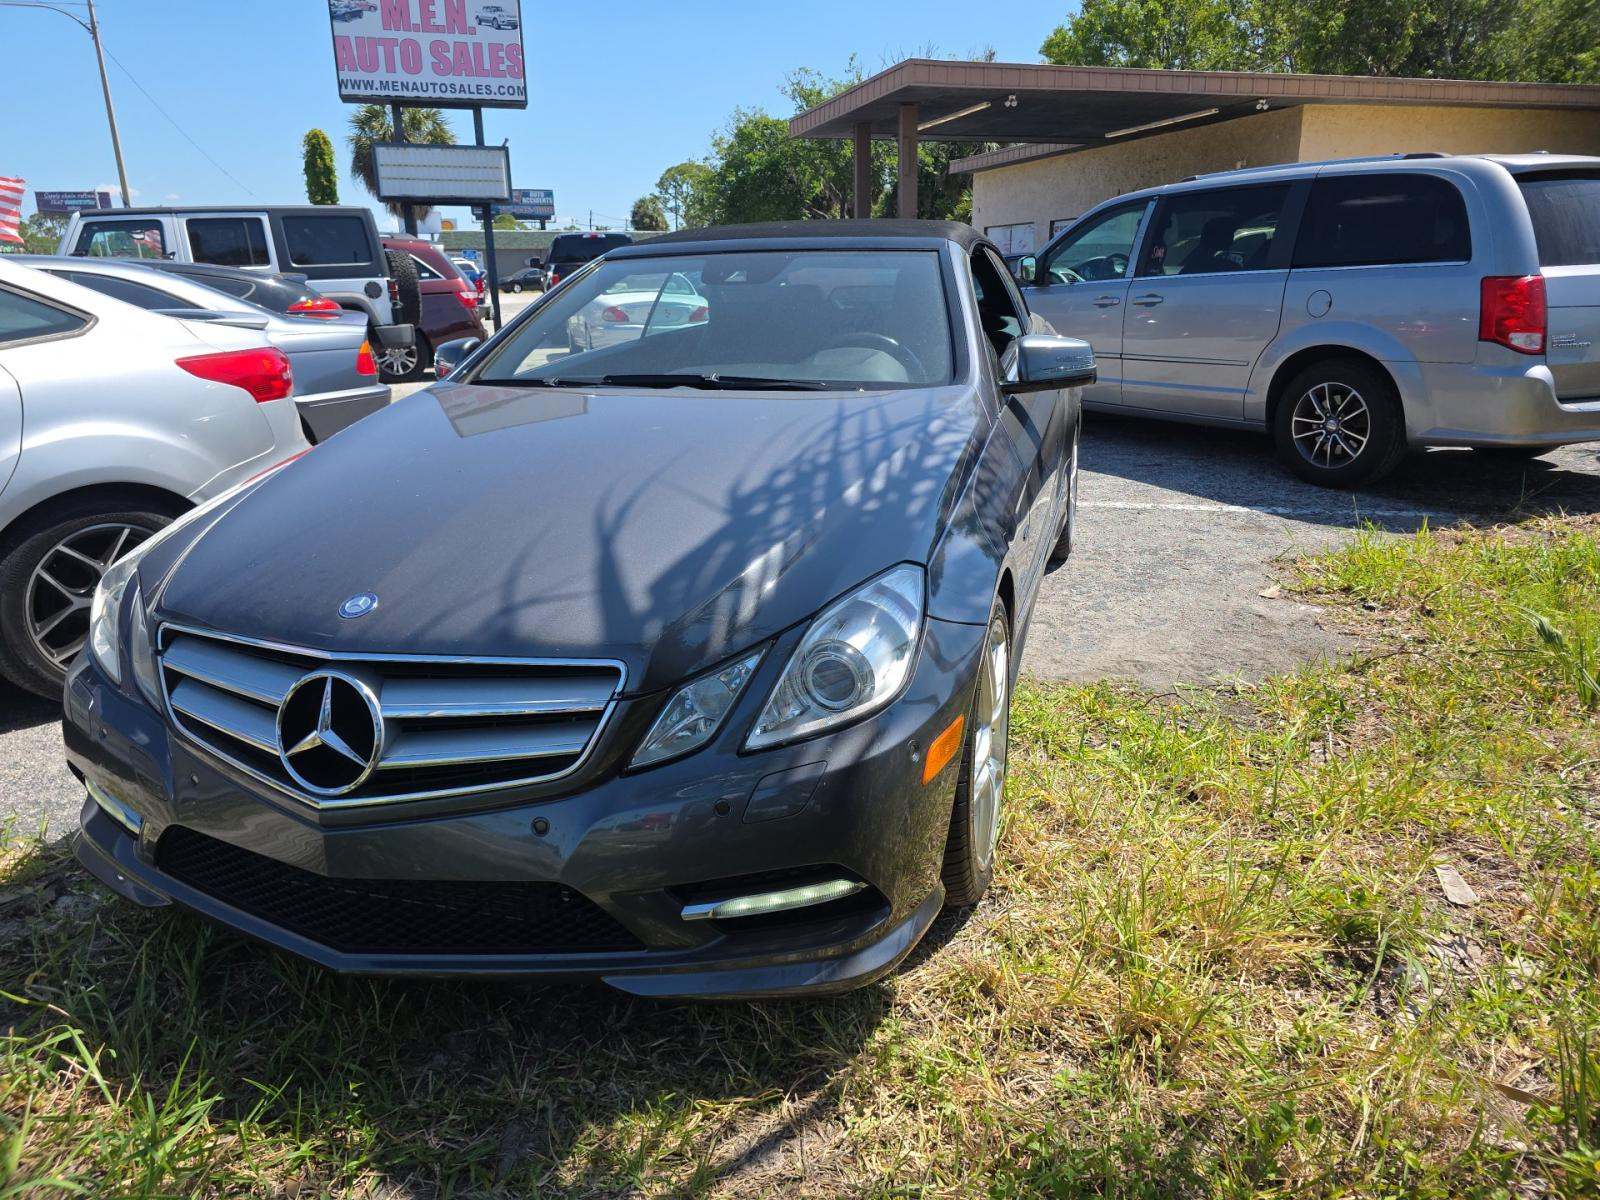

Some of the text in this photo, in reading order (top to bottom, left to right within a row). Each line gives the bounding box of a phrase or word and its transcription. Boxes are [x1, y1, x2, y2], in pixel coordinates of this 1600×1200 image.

[380, 0, 477, 36] M.E.N.
[334, 35, 523, 79] AUTO SALES
